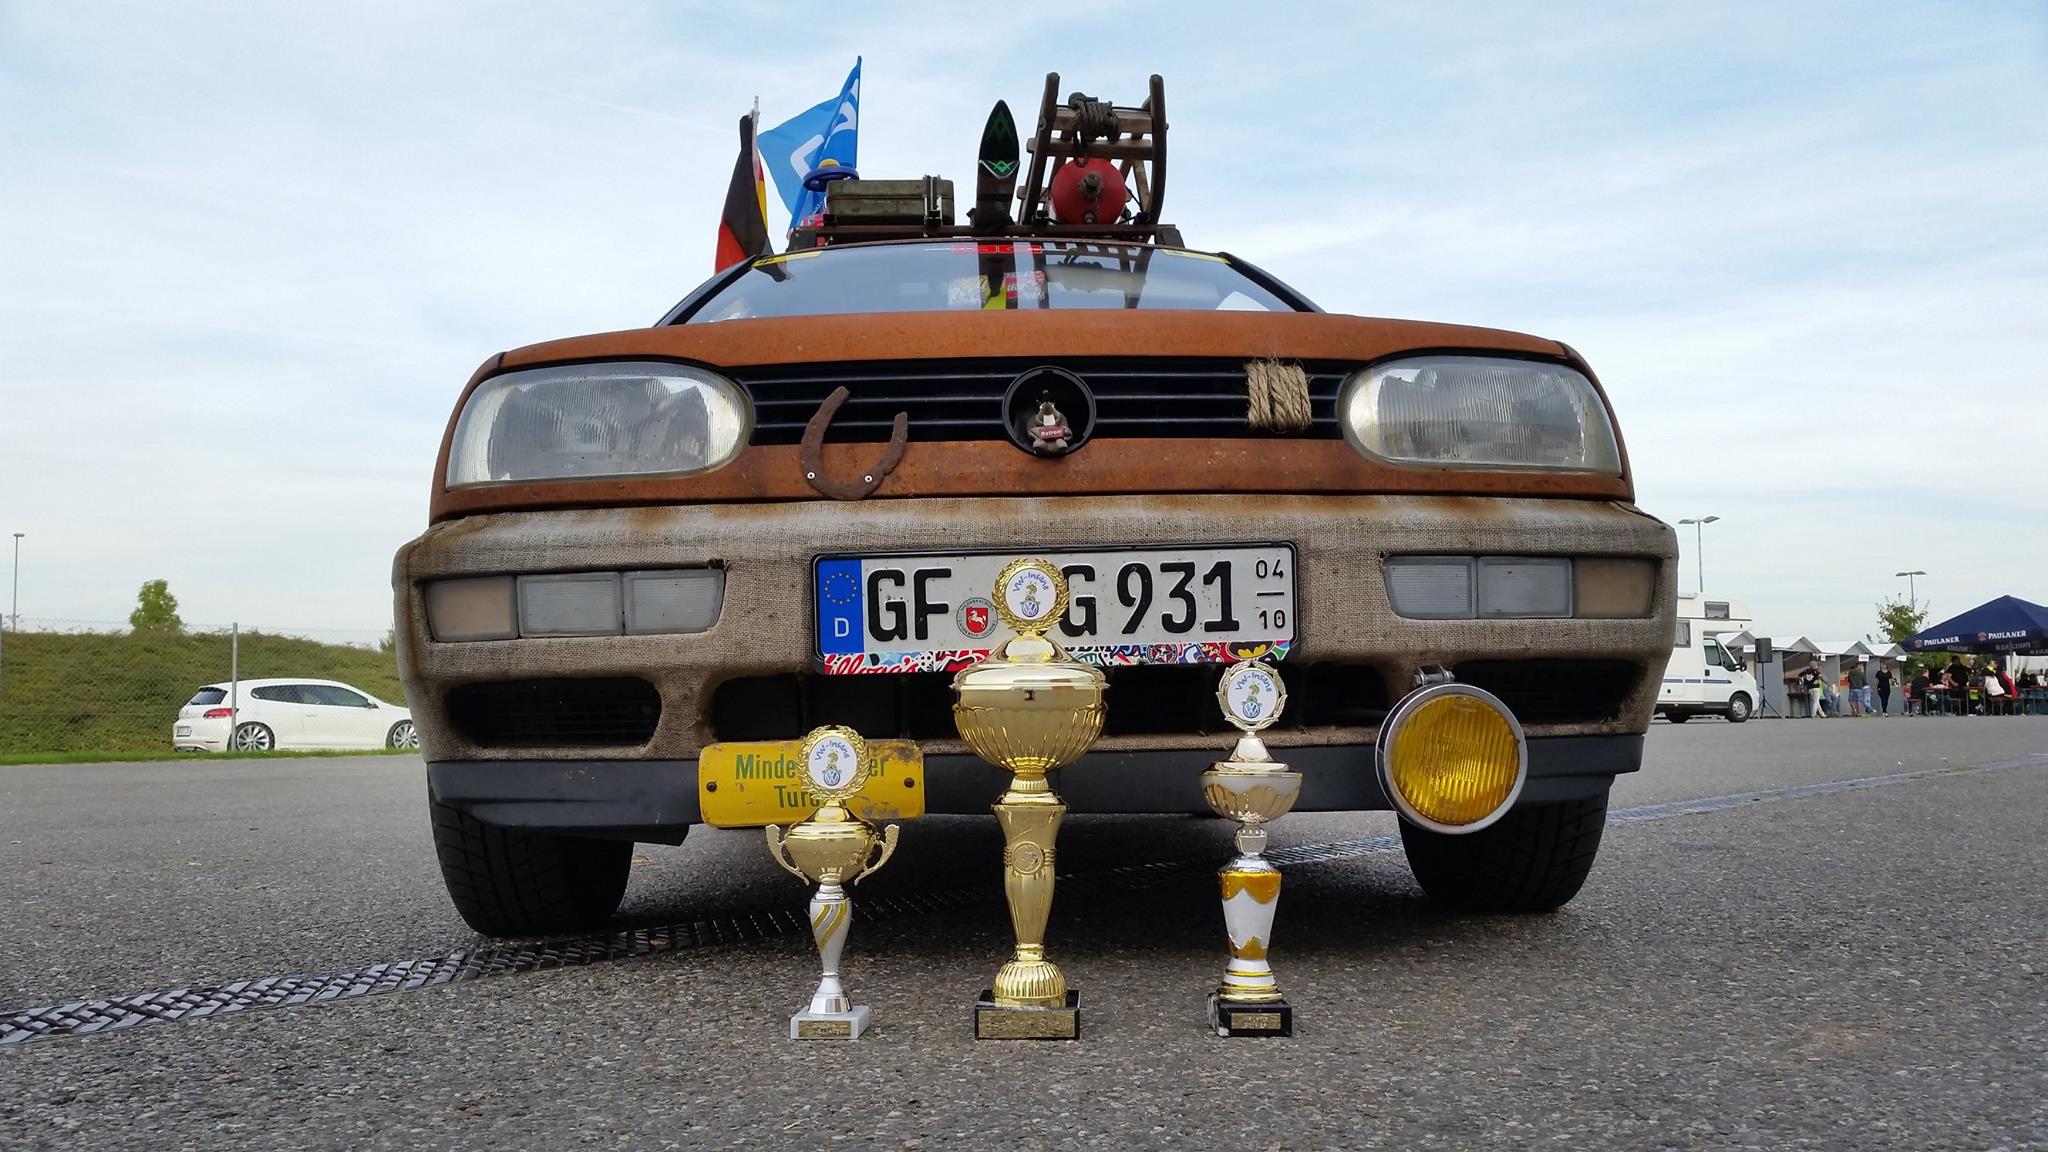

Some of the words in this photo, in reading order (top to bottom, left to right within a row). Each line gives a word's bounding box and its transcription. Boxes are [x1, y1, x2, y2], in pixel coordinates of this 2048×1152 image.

[1256, 559, 1284, 578] 04
[867, 566, 952, 641] GF
[1058, 564, 1097, 637] G
[1115, 561, 1241, 635] 931
[833, 616, 851, 638] D
[1259, 609, 1286, 629] 10
[1923, 636, 1960, 646] PAULANER
[1988, 630, 2027, 640] PAULANER
